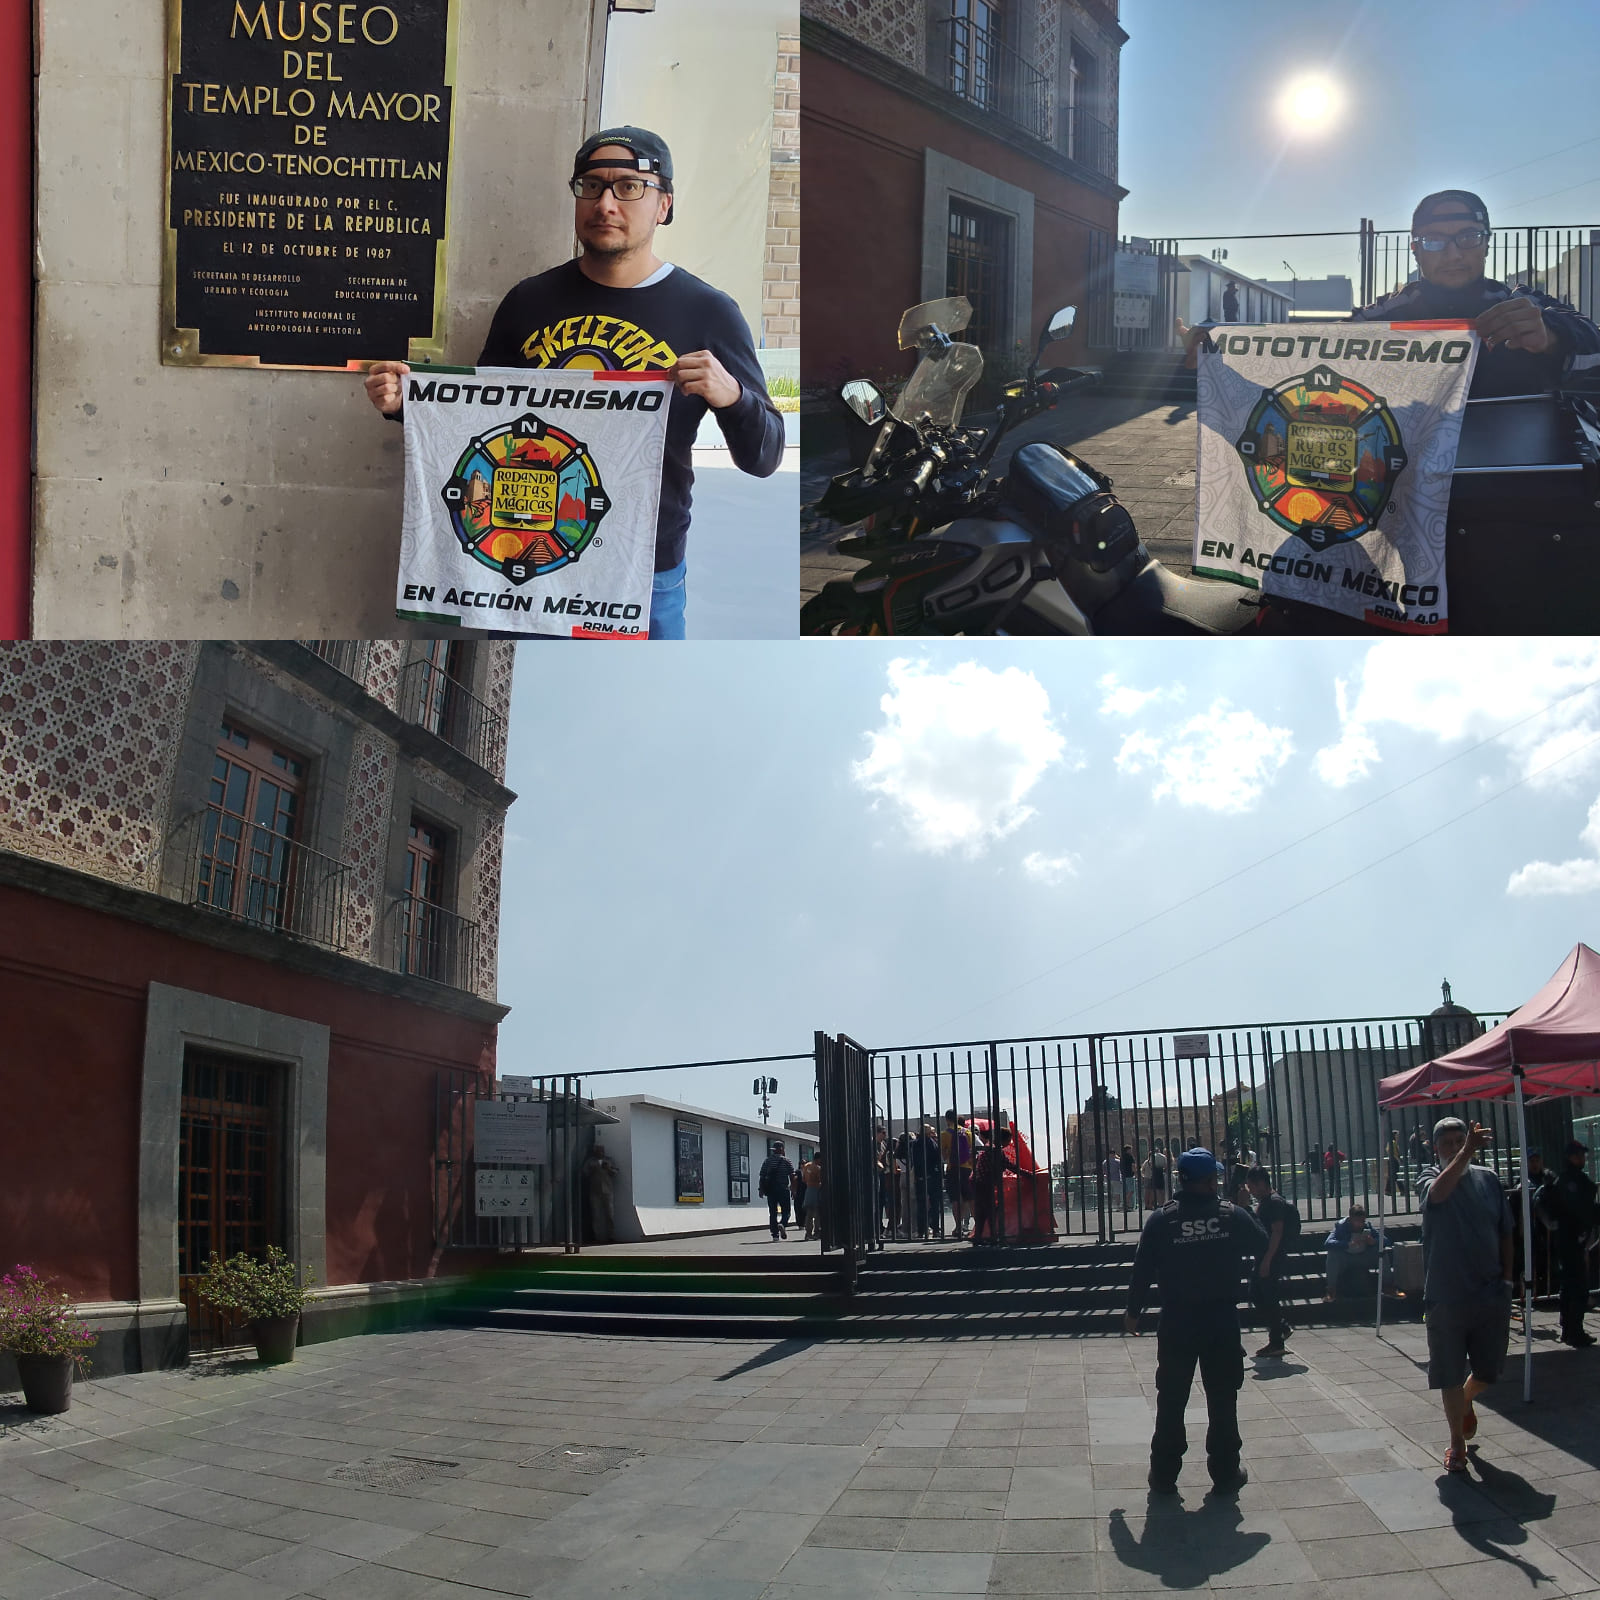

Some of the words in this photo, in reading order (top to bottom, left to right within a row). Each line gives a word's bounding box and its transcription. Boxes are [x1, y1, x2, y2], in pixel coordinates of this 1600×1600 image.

[230, 0, 399, 46] MUSEO
[283, 50, 343, 82] DEL
[182, 82, 316, 117] TEMPLO
[327, 89, 441, 123] MAYOR
[294, 125, 327, 146] DE
[219, 192, 240, 205] FUE
[247, 193, 329, 209] INAUGURADO
[336, 198, 360, 211] POR
[368, 199, 381, 211] EL
[387, 200, 398, 212] C.
[183, 208, 277, 230] PRESIDENTE
[287, 213, 305, 231] DE
[314, 215, 334, 232] LA
[345, 216, 432, 235] REPUBLICA
[223, 242, 235, 254] EL
[242, 242, 253, 255] 12
[261, 243, 275, 255] DE
[284, 243, 338, 258] OCTUBRE
[345, 246, 359, 258] DE
[366, 247, 392, 259] 1987
[193, 271, 238, 281] SECRETARIA
[241, 272, 250, 281] DE
[252, 273, 301, 283] DESARROLLO
[348, 276, 395, 286] SECRETARIA
[398, 278, 408, 287] DE
[204, 286, 237, 295] URBANO
[241, 287, 246, 295] Y
[249, 287, 289, 297] ECOLOGIA
[335, 290, 381, 300] EDUCACION
[384, 292, 418, 301] PUBLICA
[255, 309, 299, 319] INSTITUTO
[302, 311, 343, 320] NACIONAL
[346, 312, 356, 321] DE
[247, 323, 312, 333] ANTROPOLOGIA
[315, 326, 320, 334] E
[322, 326, 361, 335] HISTORIA
[519, 315, 679, 371] SKELETOR
[1201, 332, 1472, 364] MOTOTURISMO
[1313, 372, 1332, 386] N
[408, 380, 665, 412] MOTOTURISMO
[520, 420, 538, 434] N
[1390, 457, 1404, 470] E
[590, 497, 604, 511] E
[1311, 528, 1326, 542] S
[511, 565, 526, 577] S
[1200, 540, 1235, 560] EN
[1240, 547, 1333, 584] ACCIÓN
[1341, 568, 1440, 607] MÉXICO
[403, 584, 435, 603] EN
[443, 588, 533, 613] ACCIÓN
[542, 593, 642, 621] MÉXICO
[1373, 604, 1409, 623] RRM
[1414, 612, 1440, 625] 4.0
[582, 621, 614, 633] RRM
[618, 623, 640, 635] 4.0
[1181, 1217, 1221, 1237] SSC
